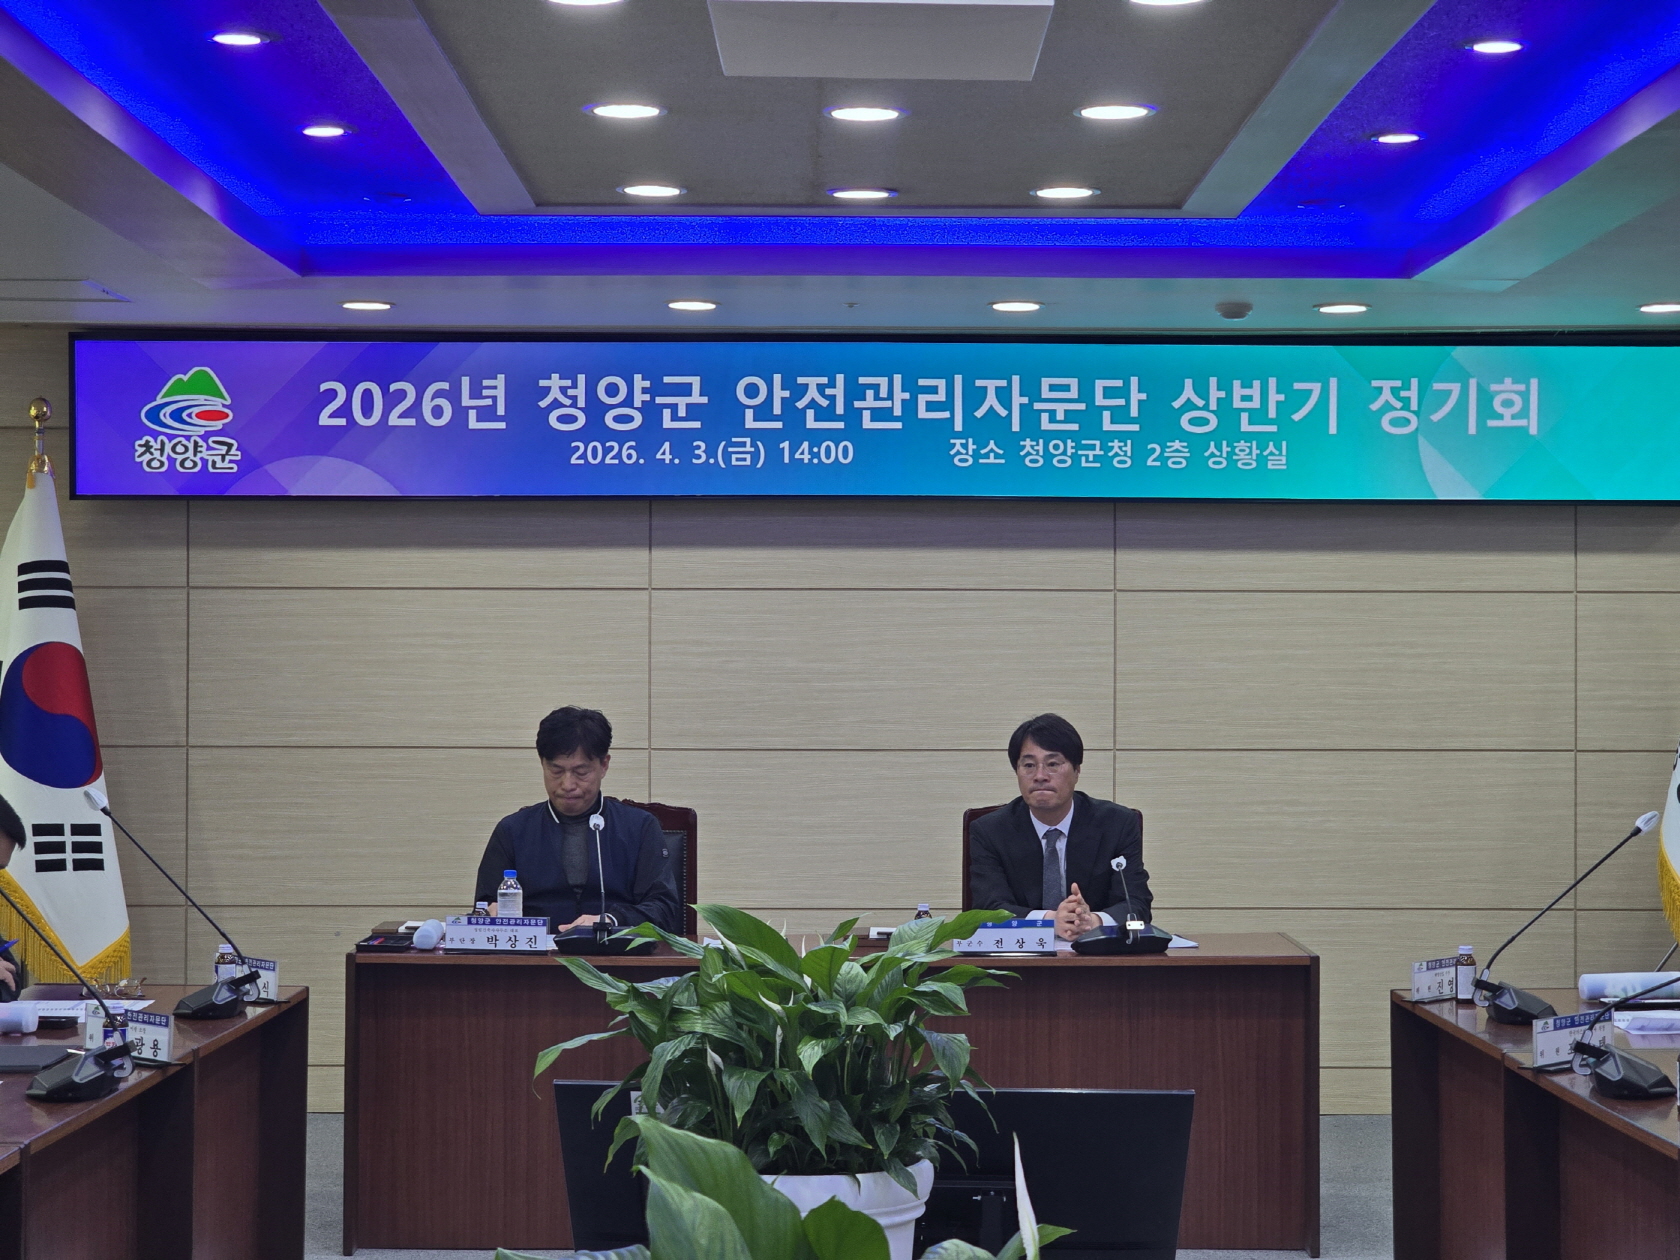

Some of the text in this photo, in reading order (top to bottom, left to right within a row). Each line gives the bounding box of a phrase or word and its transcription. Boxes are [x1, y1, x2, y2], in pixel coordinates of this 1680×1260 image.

[318, 373, 1539, 435] 2026년 청양군 안전관리자문단 상반기 정기회
[135, 435, 241, 472] 청양군
[569, 438, 854, 468] 2026. 4. 3.(금) 14:00
[949, 439, 1288, 470] 장소 청양군청 2층 상황실
[470, 917, 544, 926] 청양군 안전관리자문단
[486, 934, 538, 949] 박상진
[993, 938, 1047, 949] 전상욱
